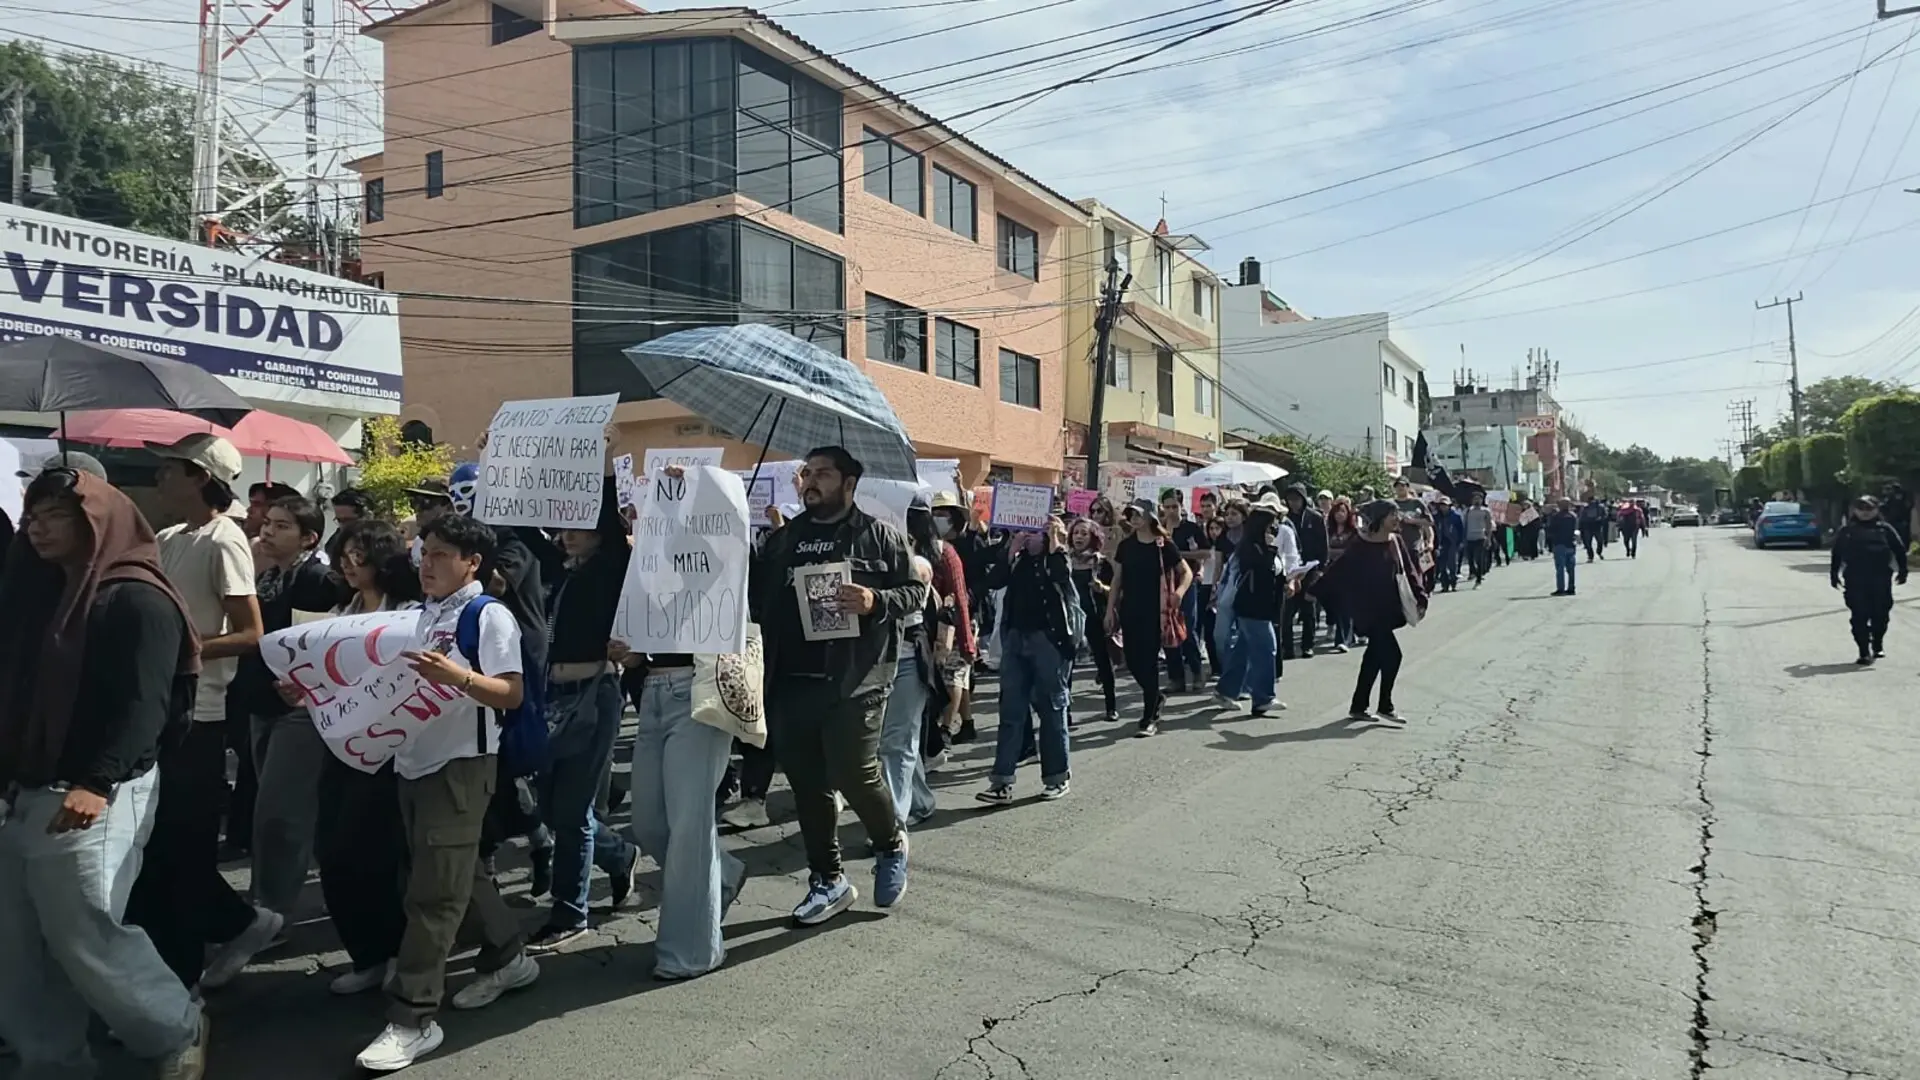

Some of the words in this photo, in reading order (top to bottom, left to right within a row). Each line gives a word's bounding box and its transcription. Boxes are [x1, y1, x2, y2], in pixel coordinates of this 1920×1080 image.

[20, 220, 195, 276] TINTORERÍA
[223, 263, 391, 316] PLANCHADURÍA
[4, 250, 343, 352] VERSIDAD
[100, 333, 187, 357] COBERTORES
[237, 368, 306, 388] EXPERIENCIA
[317, 380, 401, 400] RESPONSABILIDAD
[264, 360, 315, 377] GARANTÍA
[326, 370, 379, 387] CONFIANZA
[491, 434, 507, 458] SE
[508, 435, 566, 459] NECESITAN
[570, 437, 598, 460] PARA
[486, 464, 511, 488] QUE
[514, 465, 535, 490] LAS
[538, 468, 601, 494] AUTORIDADES
[657, 477, 687, 502] NO
[483, 496, 524, 518] HAGAN
[527, 498, 544, 518] SU
[547, 498, 598, 522] TRABAJO?
[673, 551, 710, 574] MATA
[646, 587, 738, 644] ESTADO
